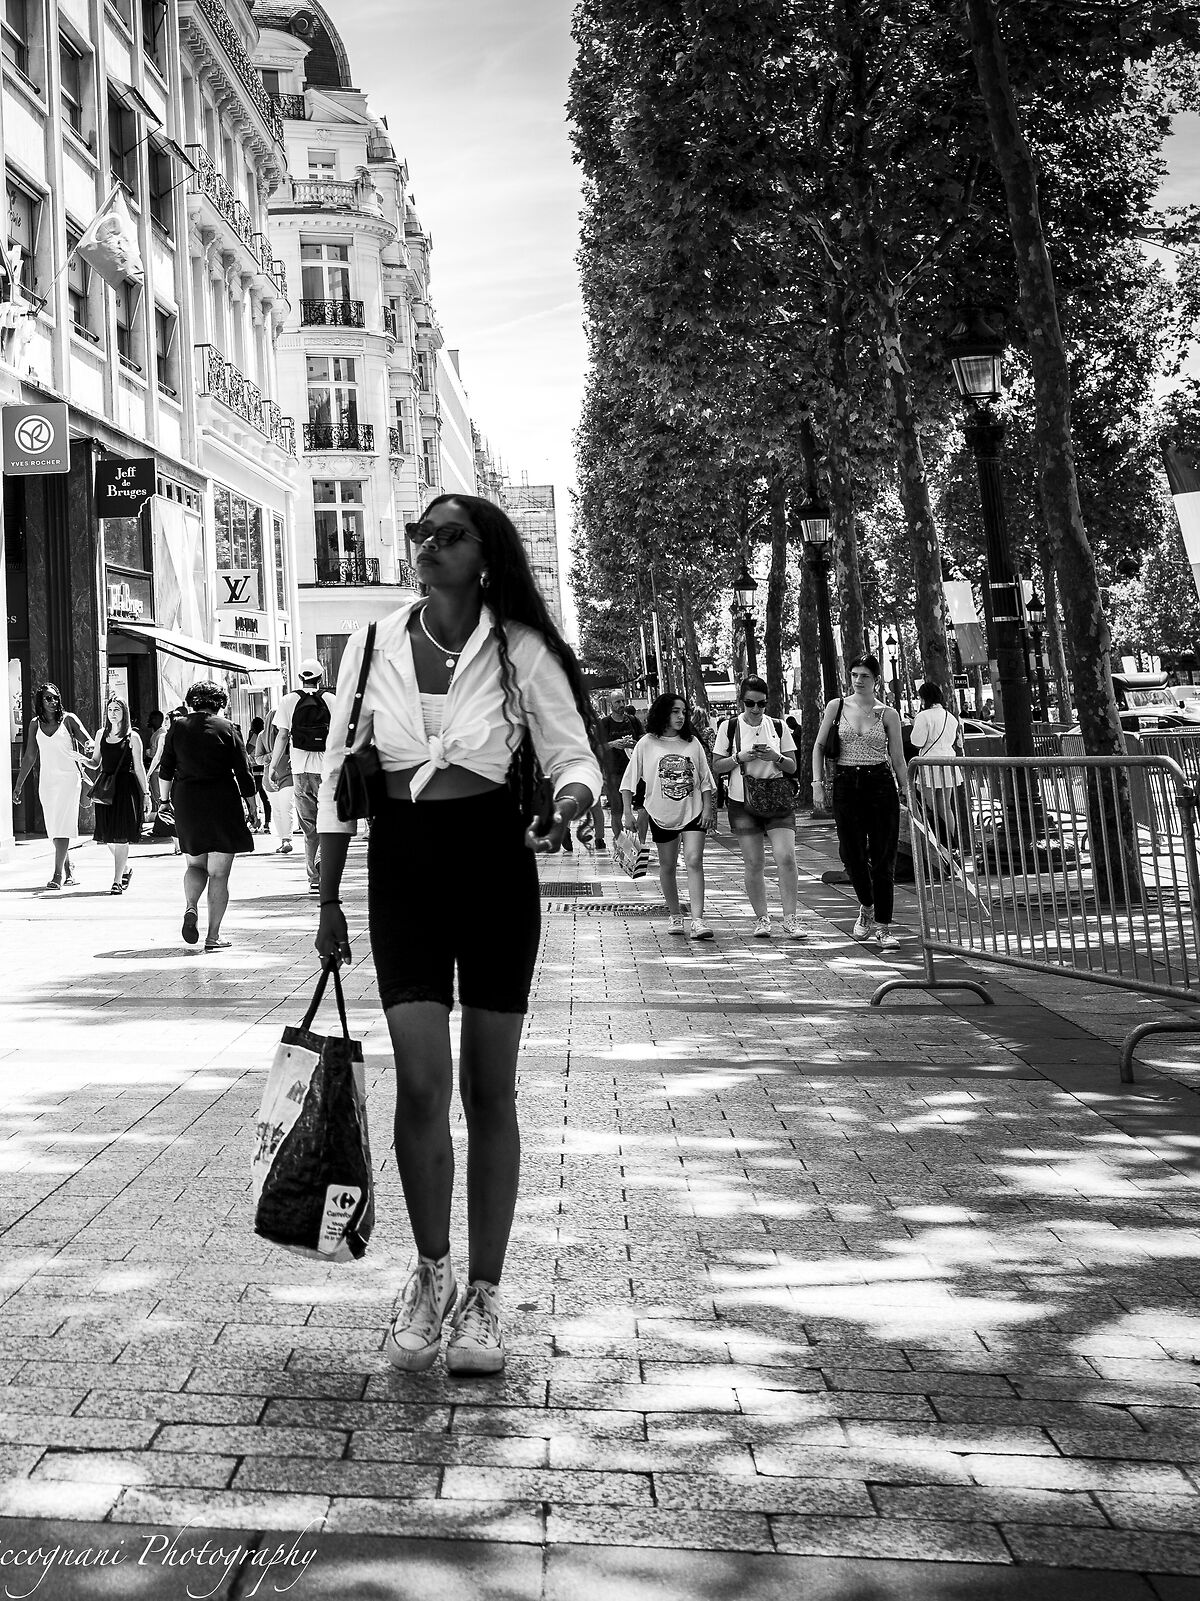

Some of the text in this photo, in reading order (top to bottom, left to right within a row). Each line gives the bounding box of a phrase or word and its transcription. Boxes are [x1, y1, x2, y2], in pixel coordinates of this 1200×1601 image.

[115, 466, 137, 480] Jeff
[121, 479, 131, 487] de
[106, 484, 147, 500] Bruges
[326, 1210, 352, 1219] Carrefo
